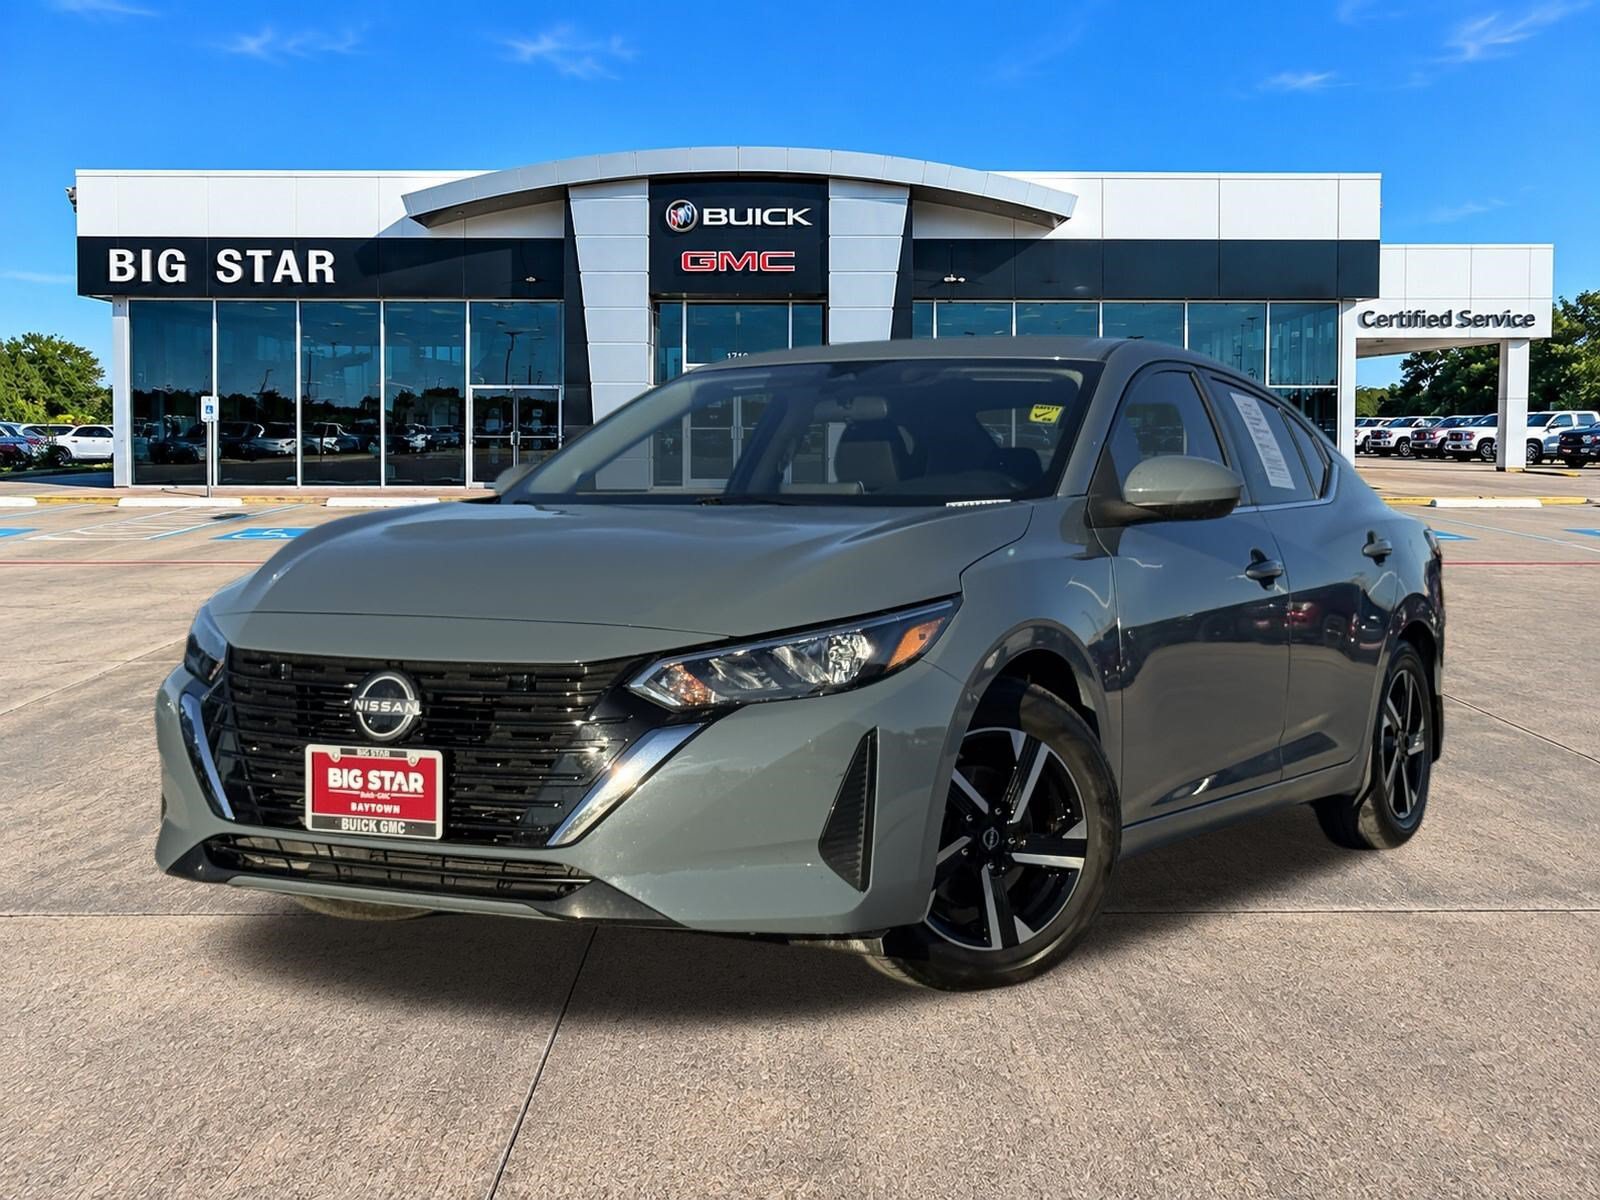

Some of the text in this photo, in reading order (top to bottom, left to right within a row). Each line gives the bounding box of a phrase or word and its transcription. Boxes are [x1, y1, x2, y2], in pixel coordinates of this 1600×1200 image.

[703, 207, 813, 226] BUICK
[109, 248, 335, 283] BIG STAR
[681, 251, 796, 272] GMC
[1358, 310, 1536, 328] Certified Service
[354, 699, 418, 713] NISSAN
[357, 749, 391, 758] BIG STAR
[327, 767, 425, 794] BIG STAR
[350, 801, 401, 815] BAYTOWN
[341, 817, 406, 835] BUICK GMC
